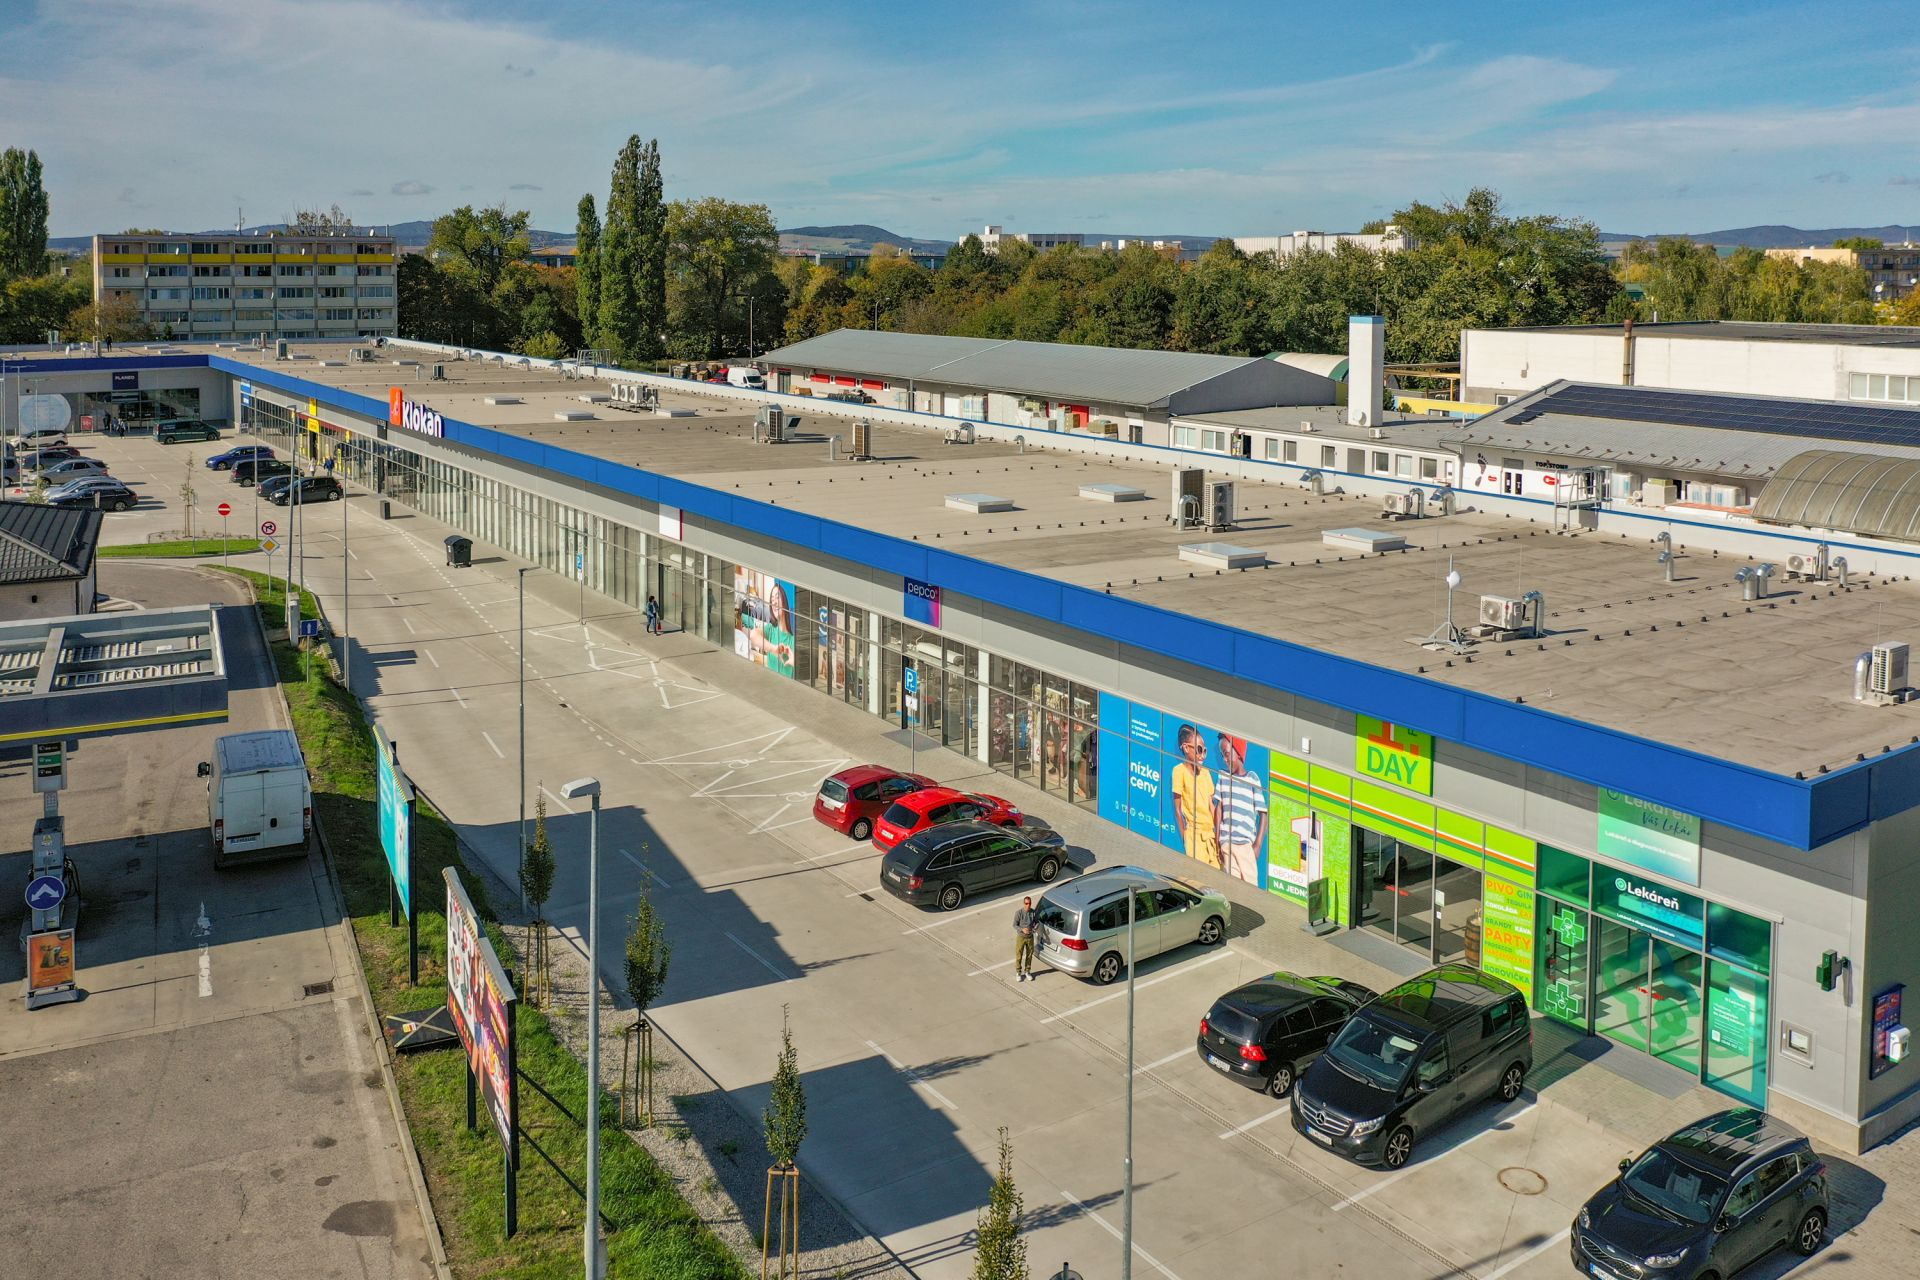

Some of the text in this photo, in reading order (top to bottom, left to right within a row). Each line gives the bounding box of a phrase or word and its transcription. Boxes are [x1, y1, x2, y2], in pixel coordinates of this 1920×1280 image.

[402, 401, 442, 438] Klokan
[907, 582, 936, 599] pepco
[1367, 745, 1419, 784] DAY
[1130, 776, 1158, 798] ceny
[1273, 880, 1285, 891] NA
[1486, 880, 1514, 896] PIVO
[1517, 890, 1533, 900] GIN
[1627, 881, 1680, 910] Lekáreň
[1485, 917, 1512, 929] BRANDY
[1485, 927, 1532, 949] PARTY
[1484, 964, 1531, 985] BOROVIČKA
